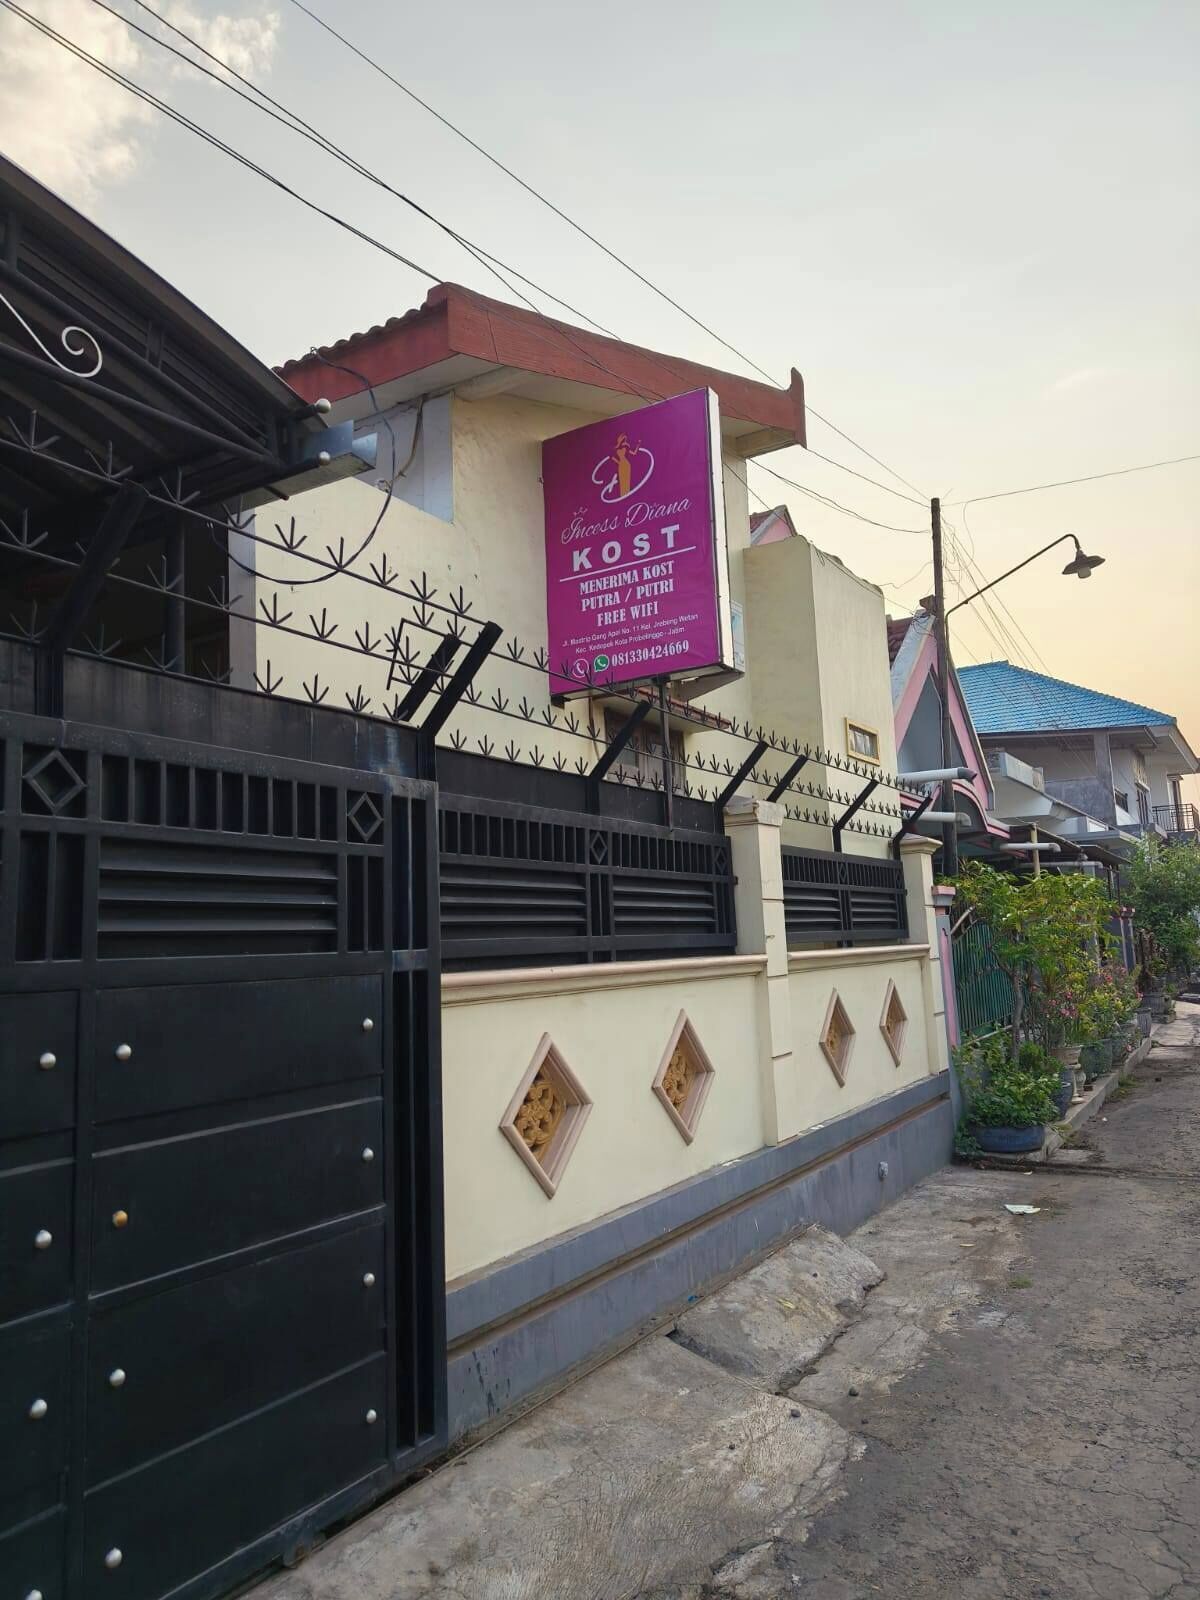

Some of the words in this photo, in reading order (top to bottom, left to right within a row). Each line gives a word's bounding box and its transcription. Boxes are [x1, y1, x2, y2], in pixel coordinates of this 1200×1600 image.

[625, 498, 691, 527] Diana
[572, 525, 680, 572] KOST
[580, 570, 639, 595] MENERIMA
[643, 560, 675, 579] KOST
[581, 592, 621, 612] PUTRA
[624, 588, 632, 603] /
[636, 579, 675, 600] PUTRI
[597, 609, 626, 627] FREE
[630, 601, 659, 619] WIFI
[591, 633, 607, 641] Gang
[611, 639, 690, 667] 081330424669
